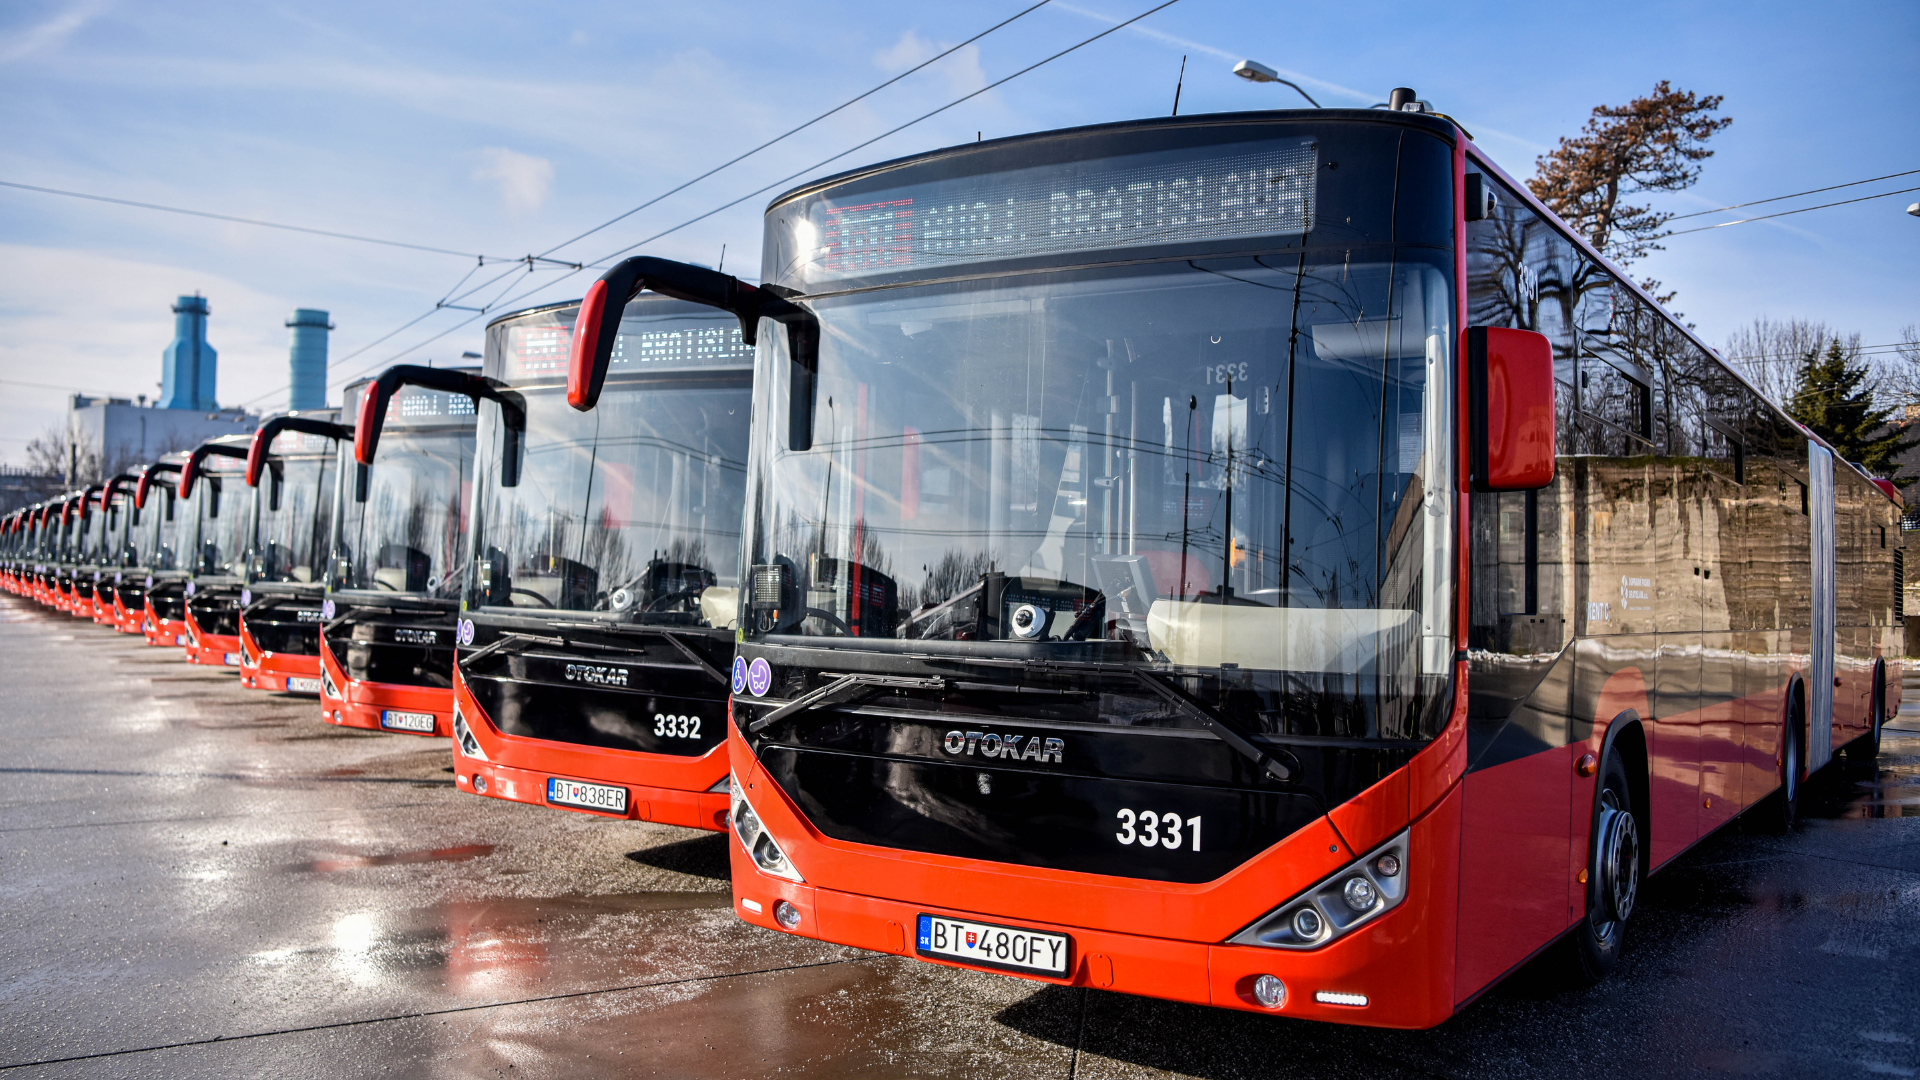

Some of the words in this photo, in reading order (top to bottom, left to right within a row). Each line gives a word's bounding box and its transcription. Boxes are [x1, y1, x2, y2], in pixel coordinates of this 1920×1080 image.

[1050, 167, 1303, 237] BRATISLAVA
[1518, 261, 1539, 304] 3331
[641, 326, 756, 362] BRATISLA
[1587, 601, 1604, 621] KENT
[1604, 601, 1609, 621] C
[394, 628, 437, 644] OTOKAR
[564, 663, 629, 686] OTOKAR
[653, 713, 702, 740] 3332
[944, 730, 1065, 764] OTOKAR
[556, 781, 573, 800] BT
[580, 785, 624, 809] 838ER
[1115, 808, 1202, 852] 3331
[920, 936, 930, 946] SK
[934, 921, 965, 953] BT
[978, 927, 1063, 968] 480FY
